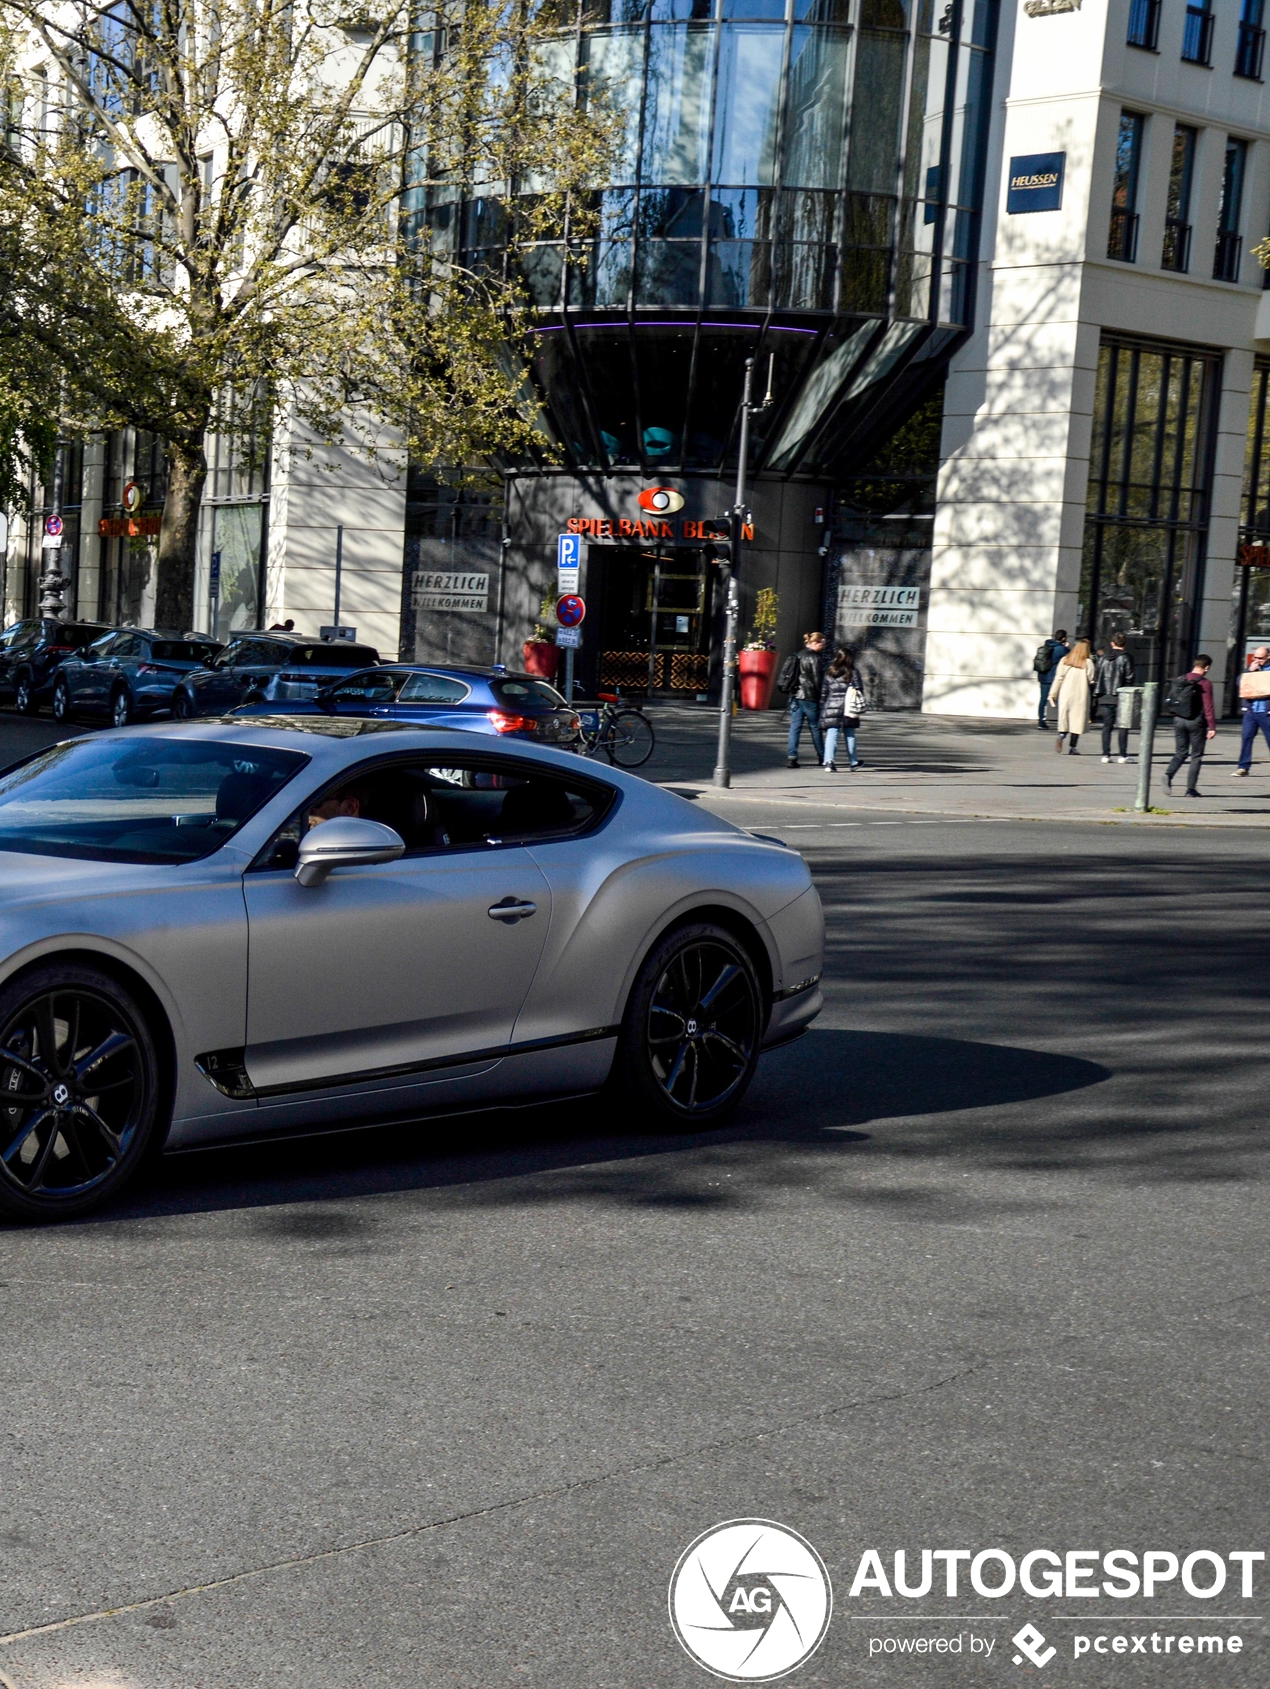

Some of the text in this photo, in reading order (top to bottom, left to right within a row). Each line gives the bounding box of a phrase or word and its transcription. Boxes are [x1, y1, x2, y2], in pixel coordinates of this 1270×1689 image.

[1011, 173, 1058, 187] HEUSSEN
[566, 517, 674, 538] SPIELBANK
[414, 574, 486, 590] HERZLICH
[413, 597, 484, 609] WILLKOMMEN
[839, 589, 917, 605] HERZLICH
[838, 612, 914, 624] WILLKOMMEN
